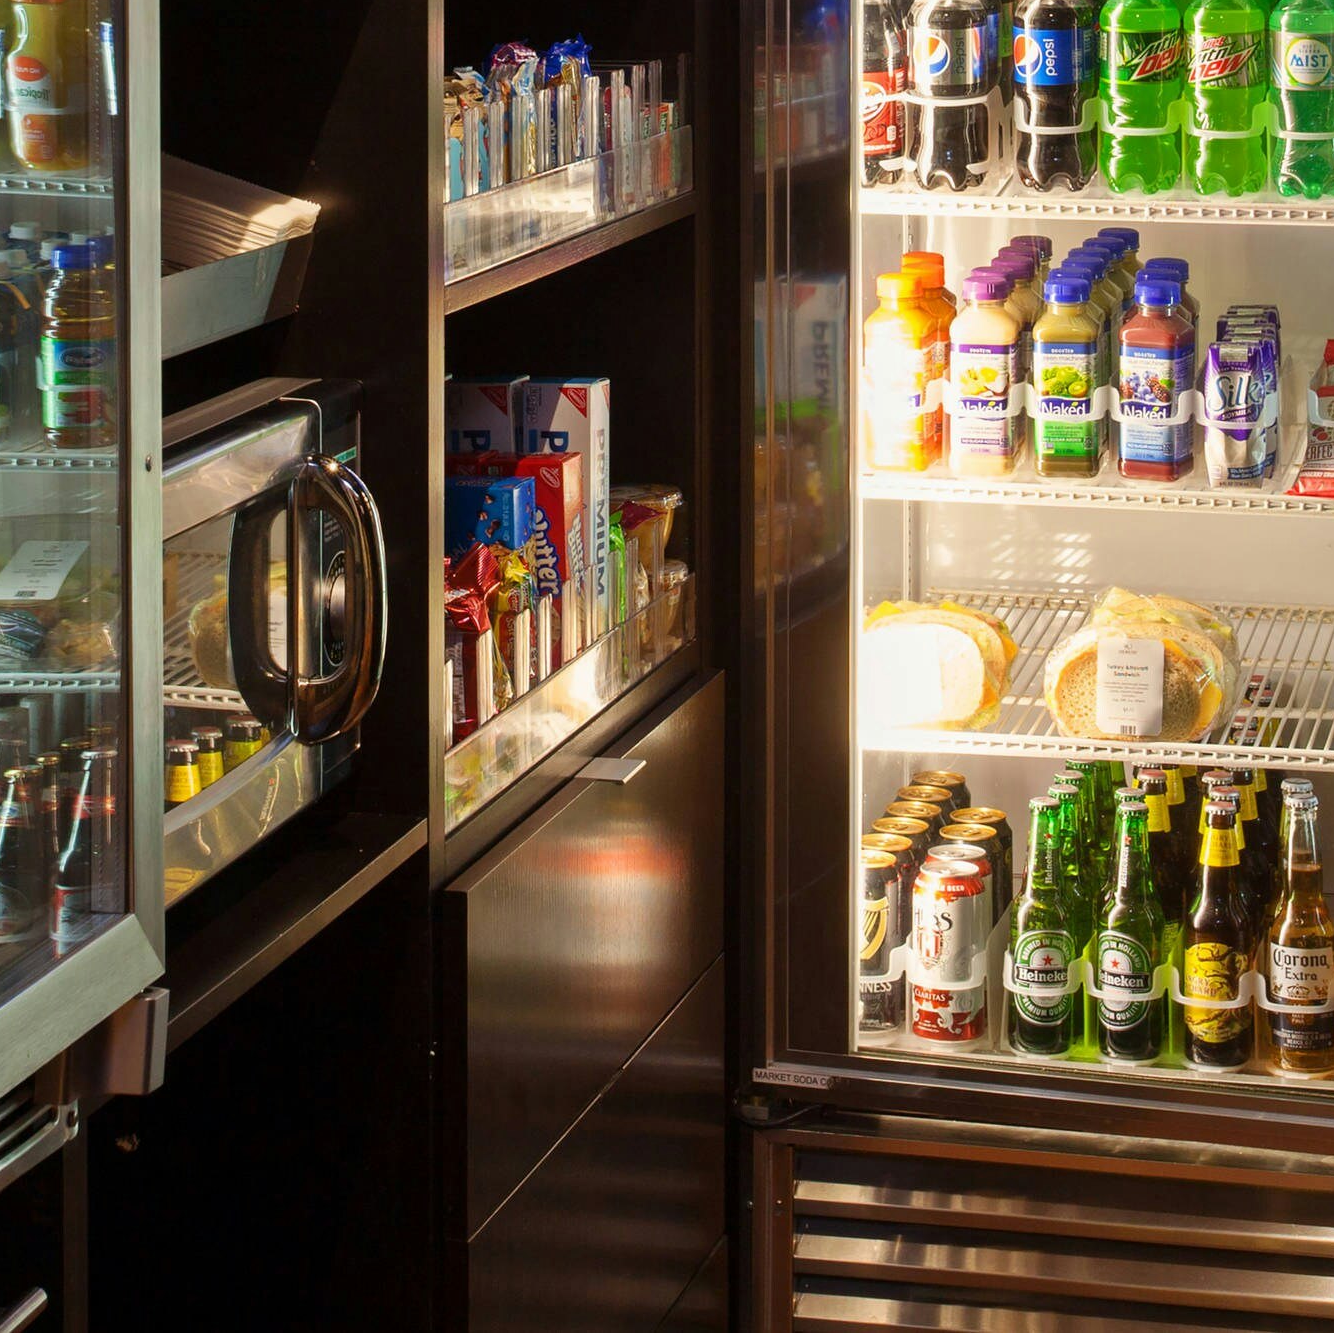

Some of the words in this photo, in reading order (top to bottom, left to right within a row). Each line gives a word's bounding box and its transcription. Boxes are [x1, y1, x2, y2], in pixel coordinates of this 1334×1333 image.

[1042, 38, 1059, 77] pepsi
[1289, 54, 1328, 69] MIST
[1208, 375, 1260, 411] Silk
[1041, 401, 1086, 417] Naked
[1123, 405, 1167, 420] Naked
[594, 428, 607, 598] PREMIUM
[1273, 947, 1330, 969] Corona
[1284, 968, 1318, 981] Extra
[860, 981, 892, 994] NNESS
